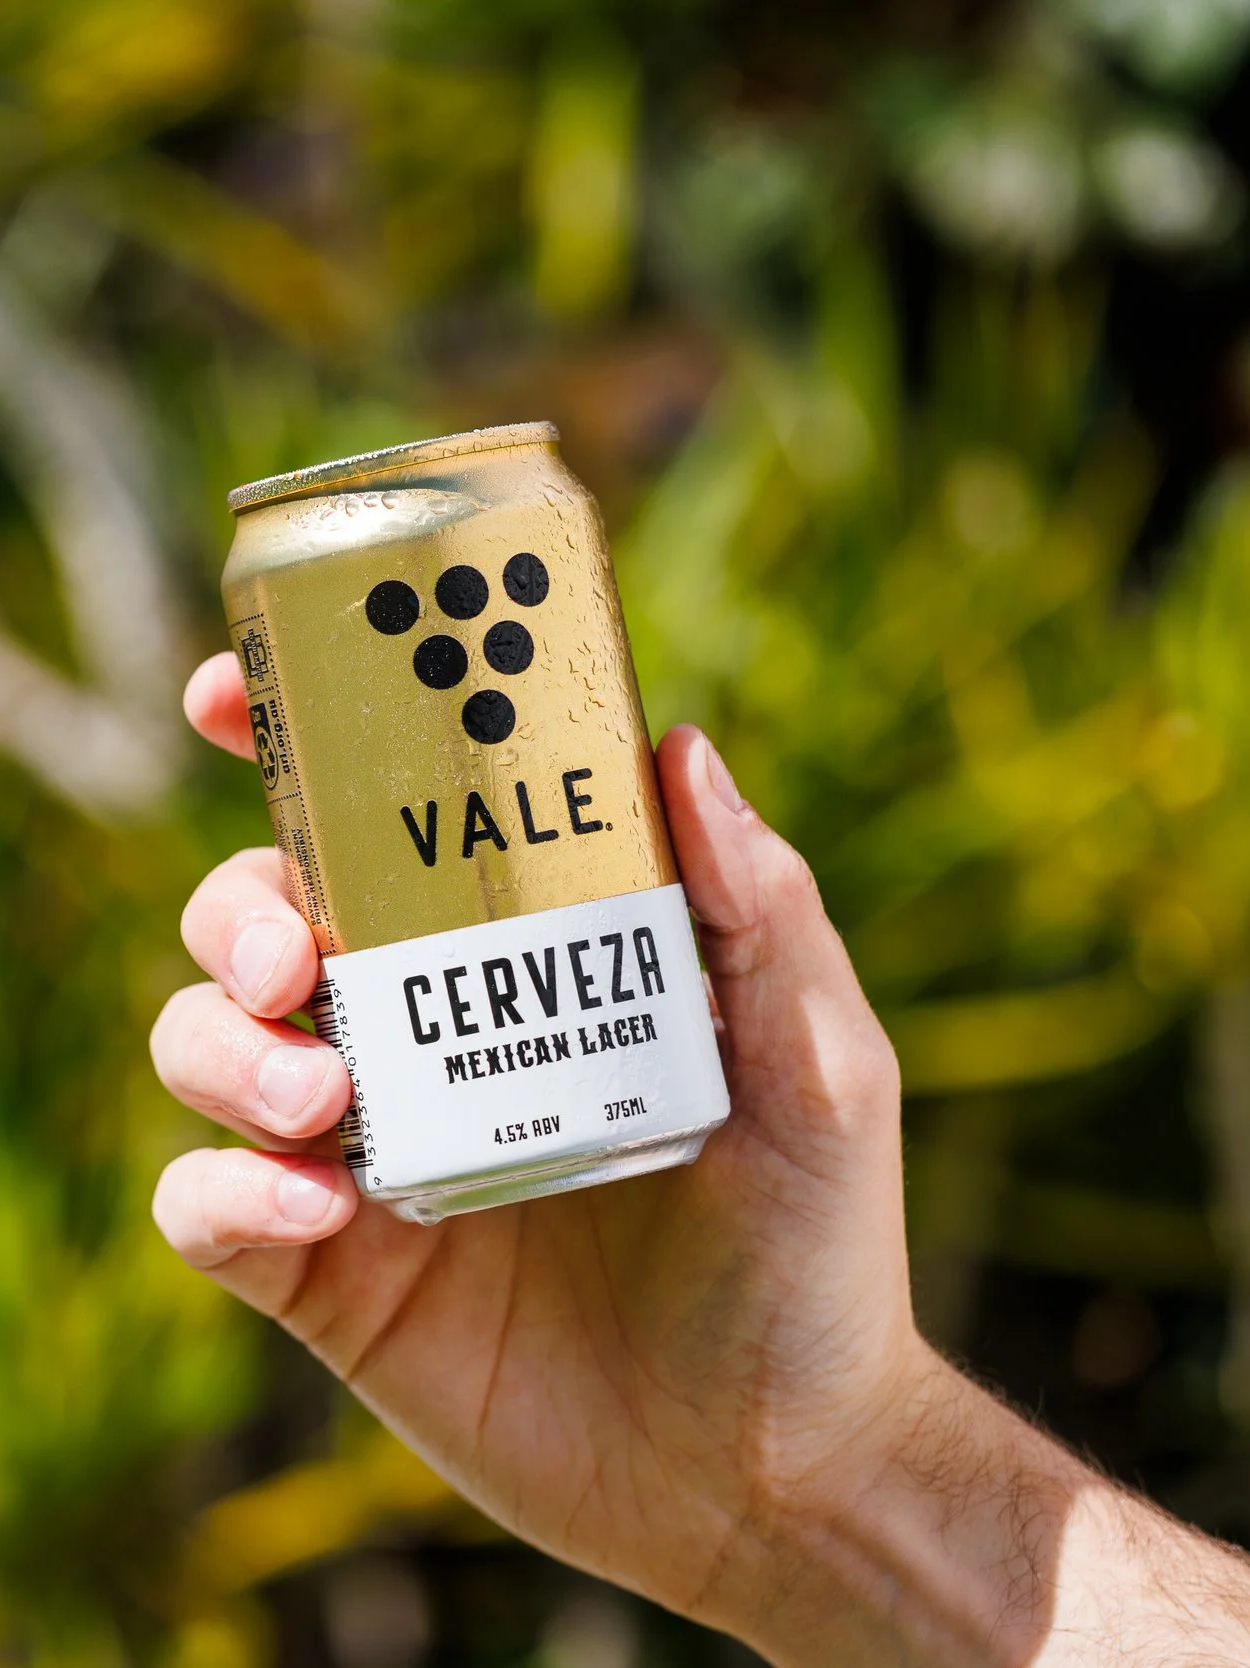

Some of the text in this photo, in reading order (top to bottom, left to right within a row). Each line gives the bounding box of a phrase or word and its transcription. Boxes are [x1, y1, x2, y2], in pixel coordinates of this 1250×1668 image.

[269, 699, 290, 773] arl.org.au
[291, 828, 317, 925] SAVOUR THE MOMENT
[297, 828, 322, 925] DRINK RESPONSIBLY
[403, 926, 666, 1045] CERVEZA
[444, 1031, 572, 1084] MEXICAN
[494, 1115, 560, 1145] 4.5% ABV
[604, 1096, 647, 1121] 375ML
